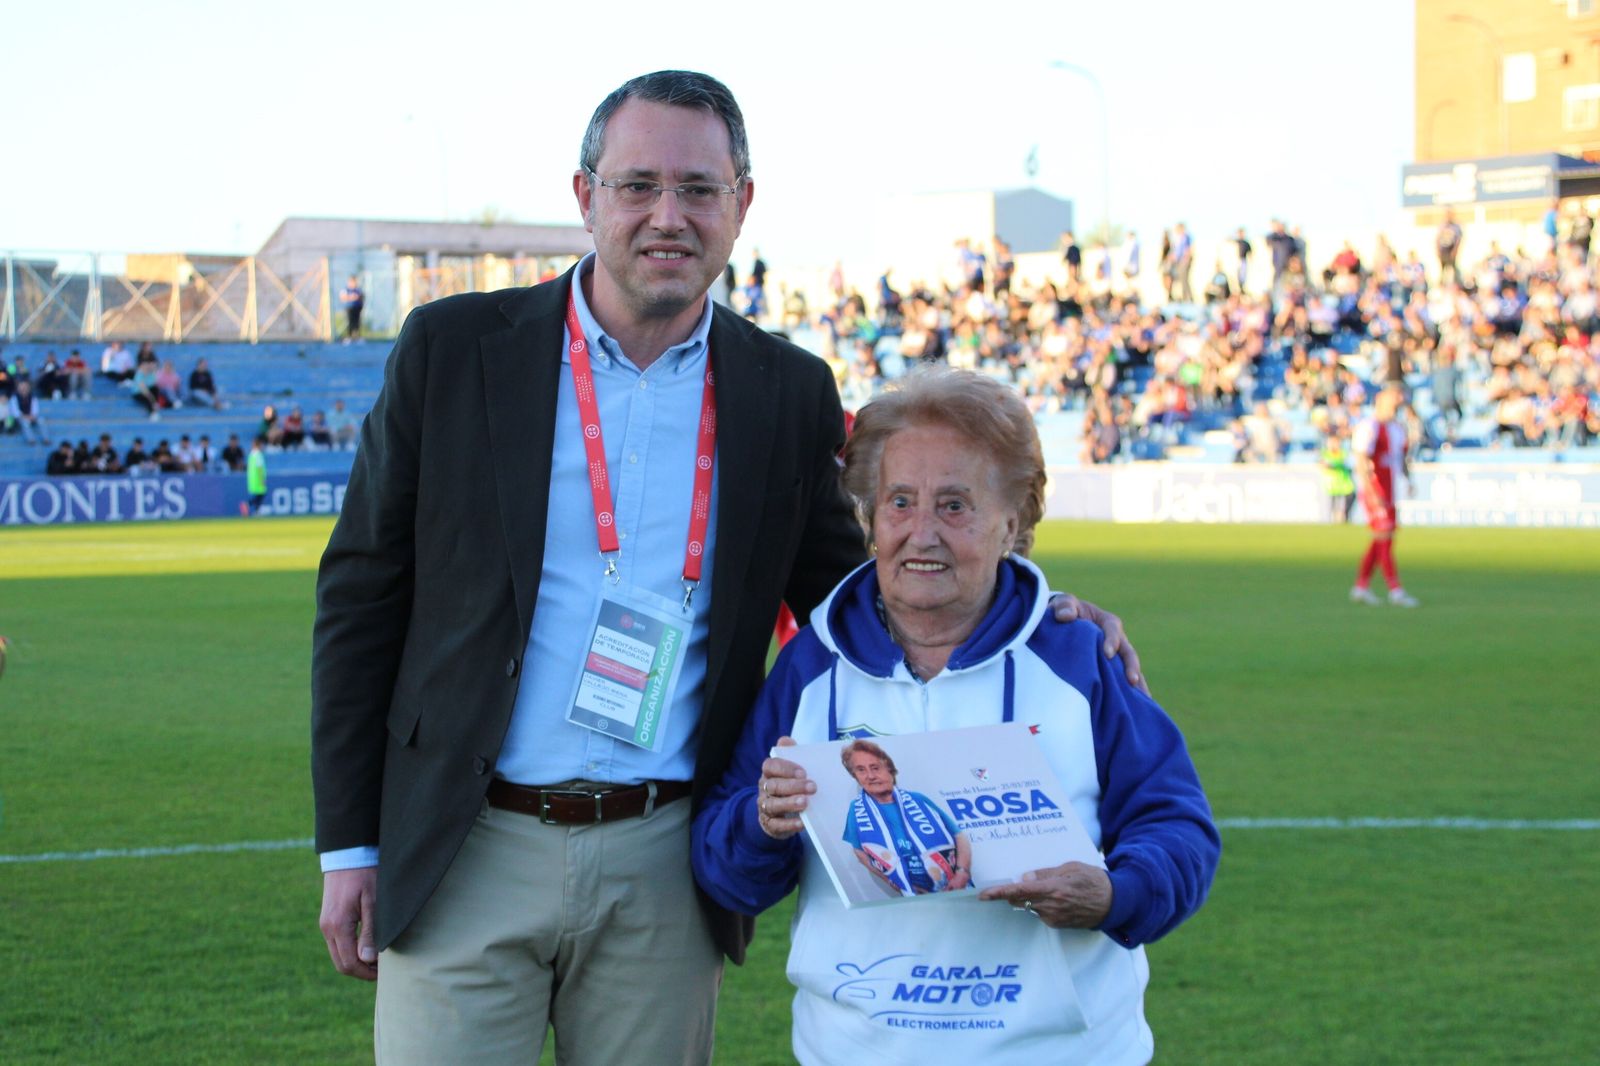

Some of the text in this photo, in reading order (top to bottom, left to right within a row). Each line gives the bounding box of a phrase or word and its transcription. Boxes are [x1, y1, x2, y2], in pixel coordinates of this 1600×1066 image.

[0, 477, 187, 524] MONTES
[606, 642, 650, 664] TEMPORADA
[640, 630, 676, 742] ORGANIZACIÓN
[946, 789, 1059, 821] ROSA
[957, 811, 1064, 830] CABRERA FERNÁNDEZ
[911, 964, 1020, 981] GARAJE
[892, 982, 1022, 1007] MOTOR
[887, 1017, 1005, 1031] ELECTROMECÁNICA
